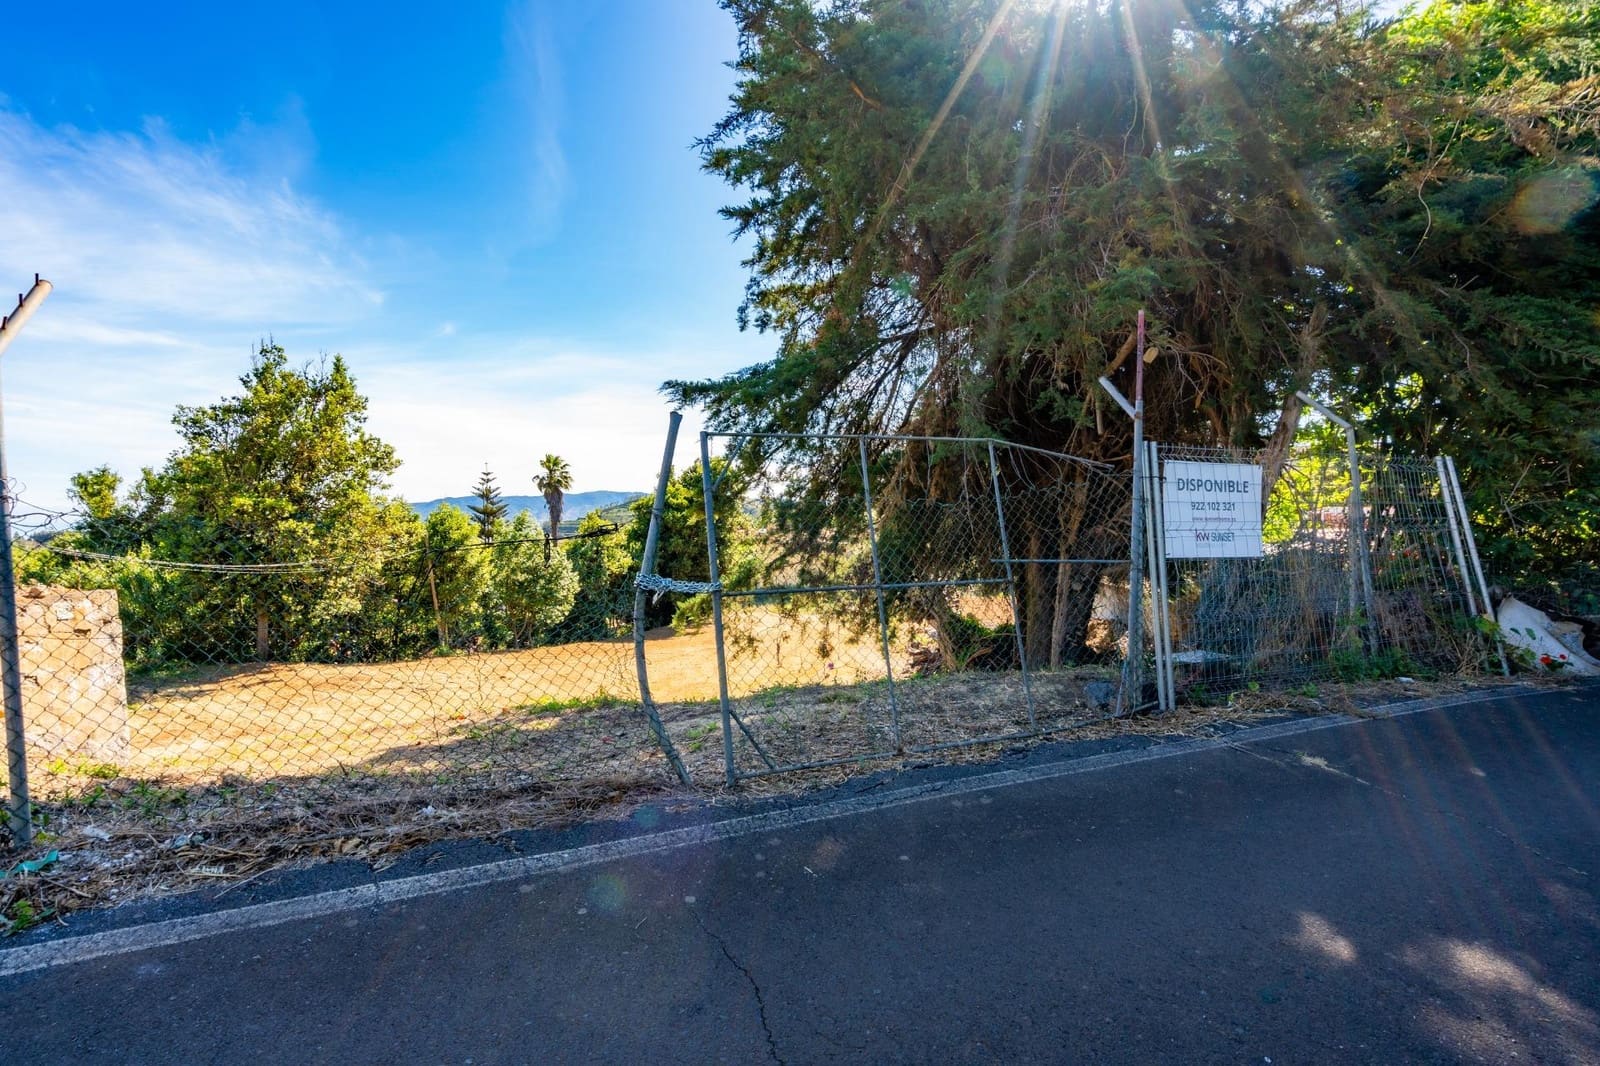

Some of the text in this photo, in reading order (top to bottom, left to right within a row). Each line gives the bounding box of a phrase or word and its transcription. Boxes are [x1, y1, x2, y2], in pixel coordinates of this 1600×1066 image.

[1177, 478, 1249, 493] DISPONIBLE
[1191, 502, 1235, 511] 922 102 321
[1211, 532, 1234, 542] SUNSET
